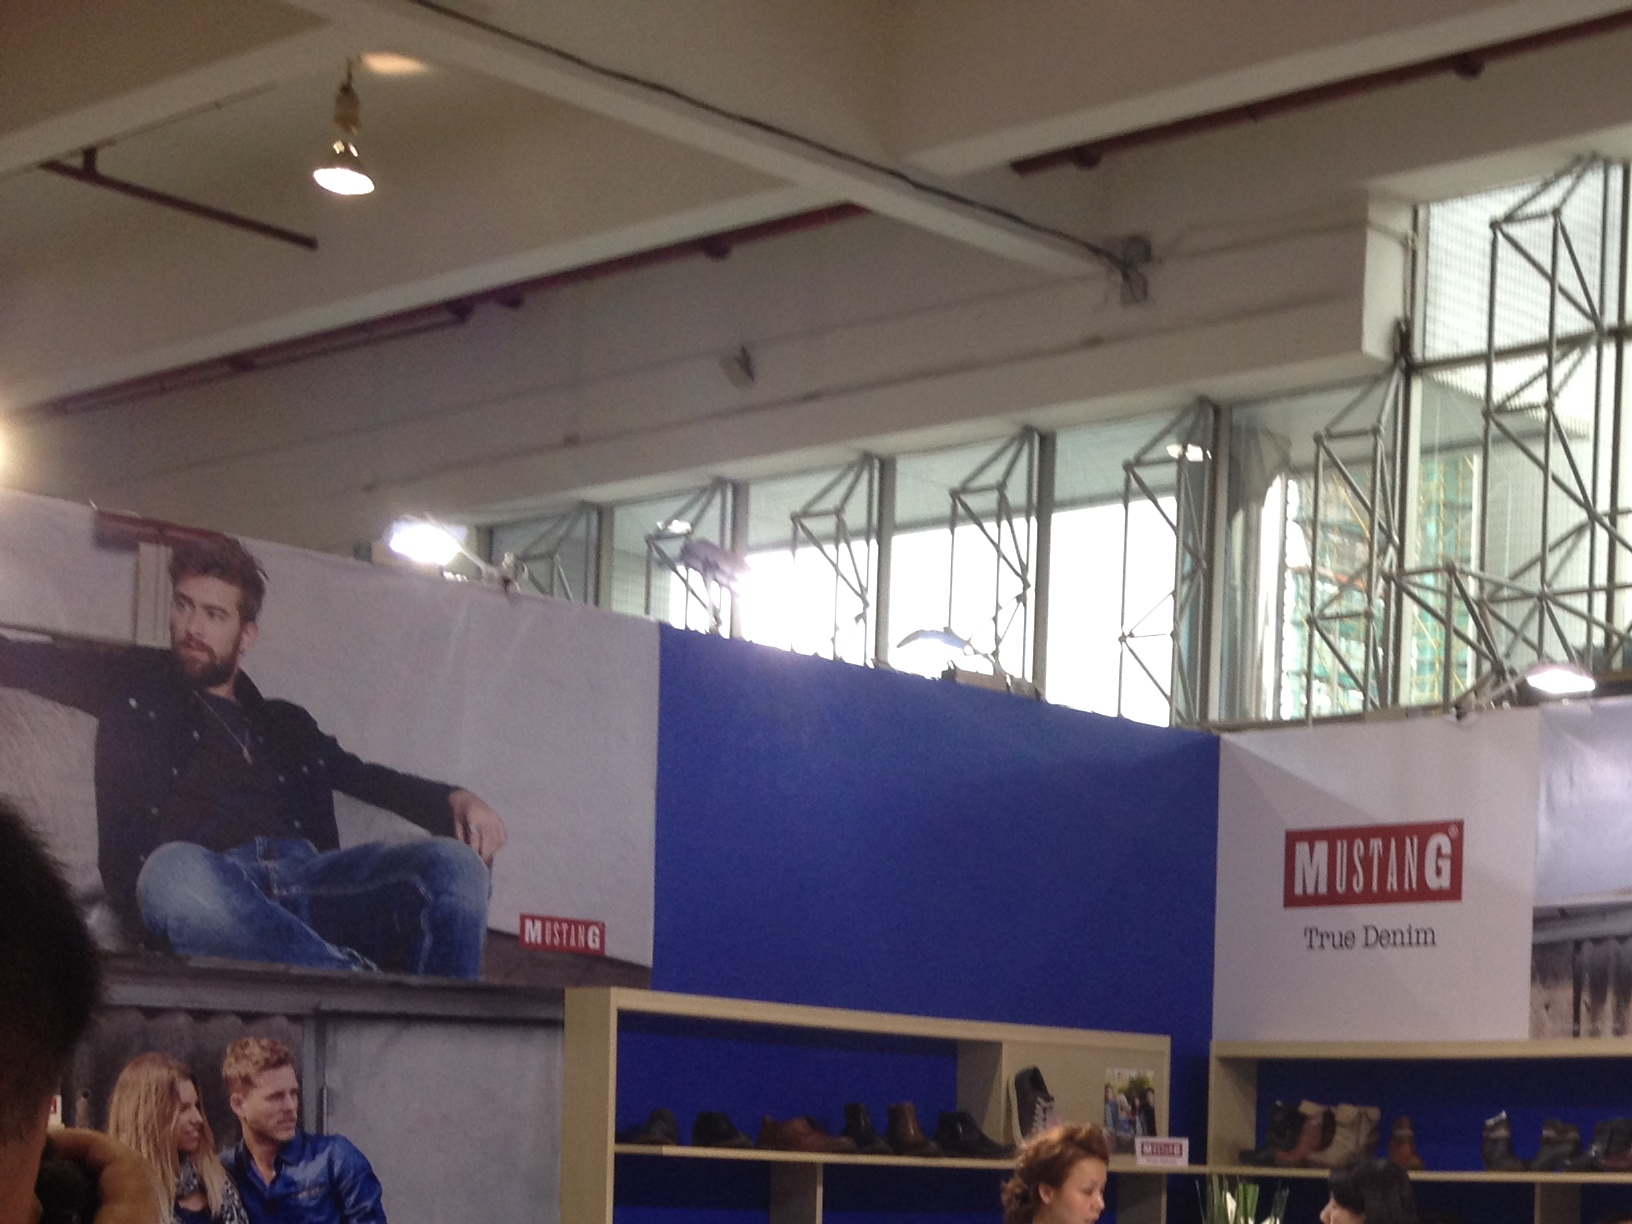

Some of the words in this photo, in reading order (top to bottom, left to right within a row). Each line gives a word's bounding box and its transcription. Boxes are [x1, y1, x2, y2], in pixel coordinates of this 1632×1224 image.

[523, 918, 601, 949] MUSTANG
[1303, 926, 1356, 950] True
[1363, 924, 1437, 949] Denim
